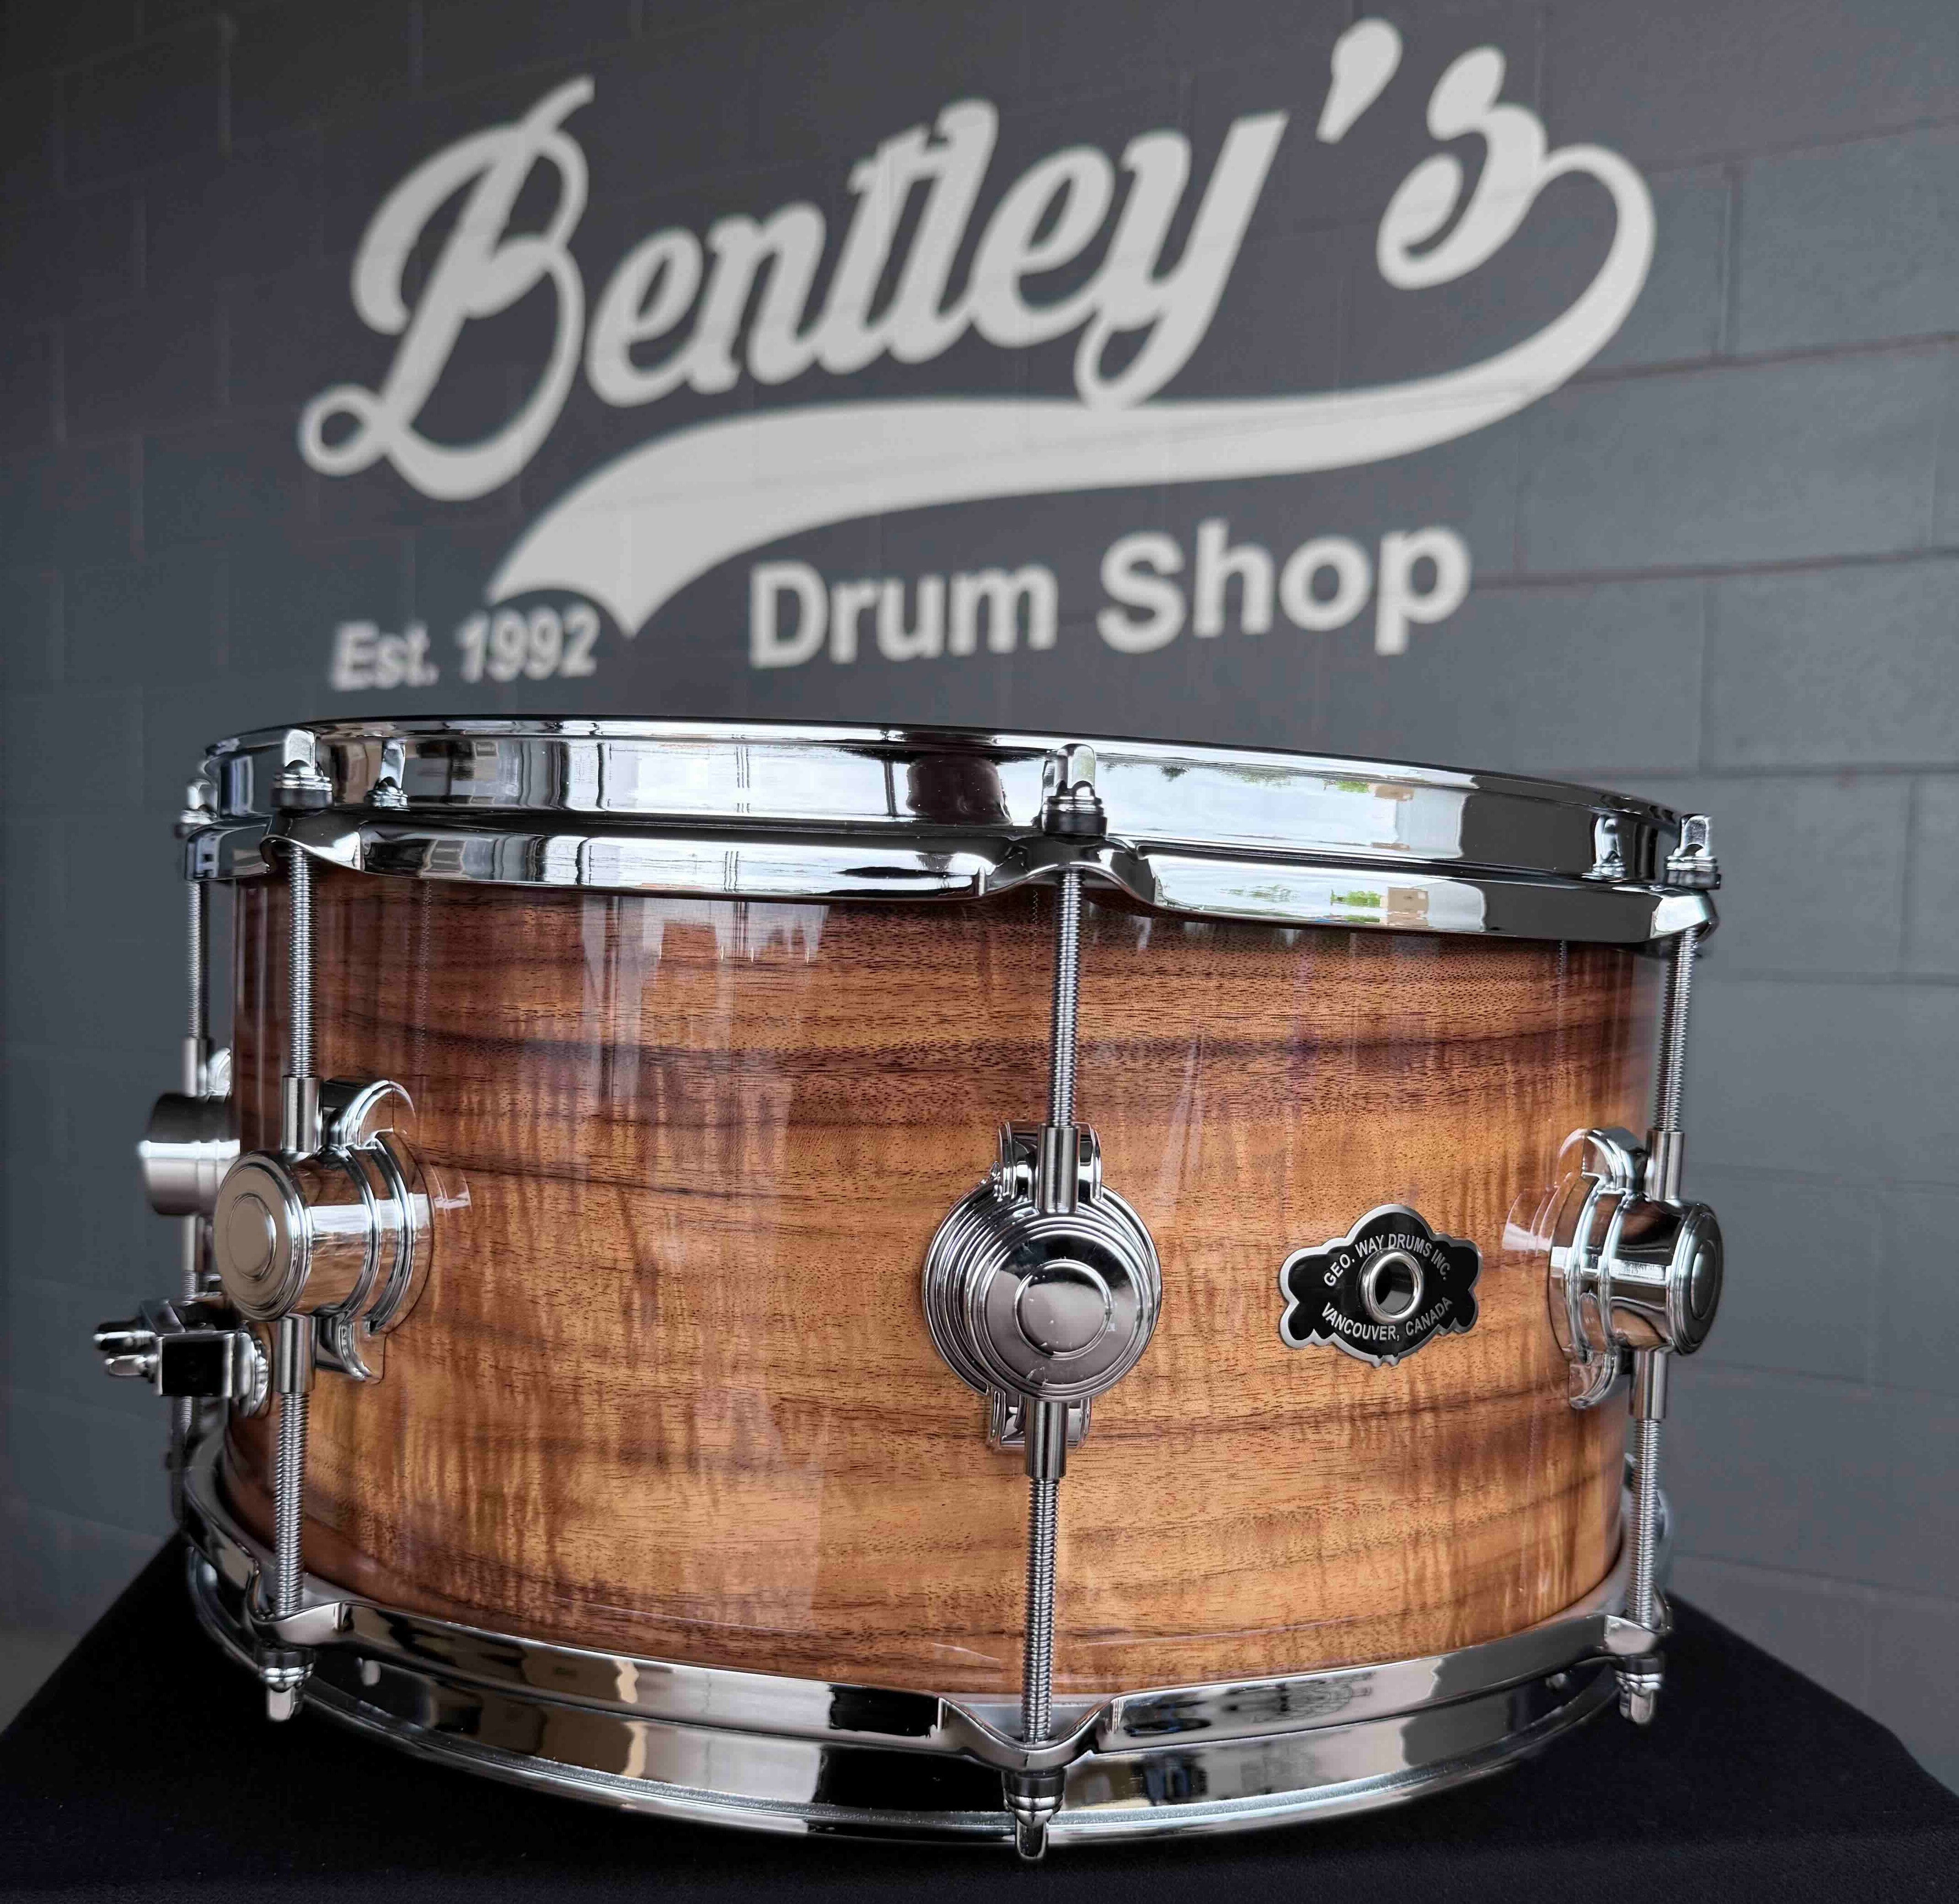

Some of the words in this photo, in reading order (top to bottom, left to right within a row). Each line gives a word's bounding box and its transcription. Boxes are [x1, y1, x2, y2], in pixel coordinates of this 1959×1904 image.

[300, 17, 1657, 500] Bentley's
[749, 562, 1059, 668] Drum
[1097, 518, 1473, 656] Shop
[331, 623, 439, 690] Est.
[459, 605, 600, 681] 1992
[1323, 1254, 1355, 1287] GEO.
[1355, 1234, 1384, 1258] WAY
[1388, 1233, 1432, 1257] DRUMS
[1431, 1249, 1451, 1280] INC.
[1322, 1302, 1399, 1341] VANCOUVER,
[1406, 1297, 1453, 1335] CANADA
